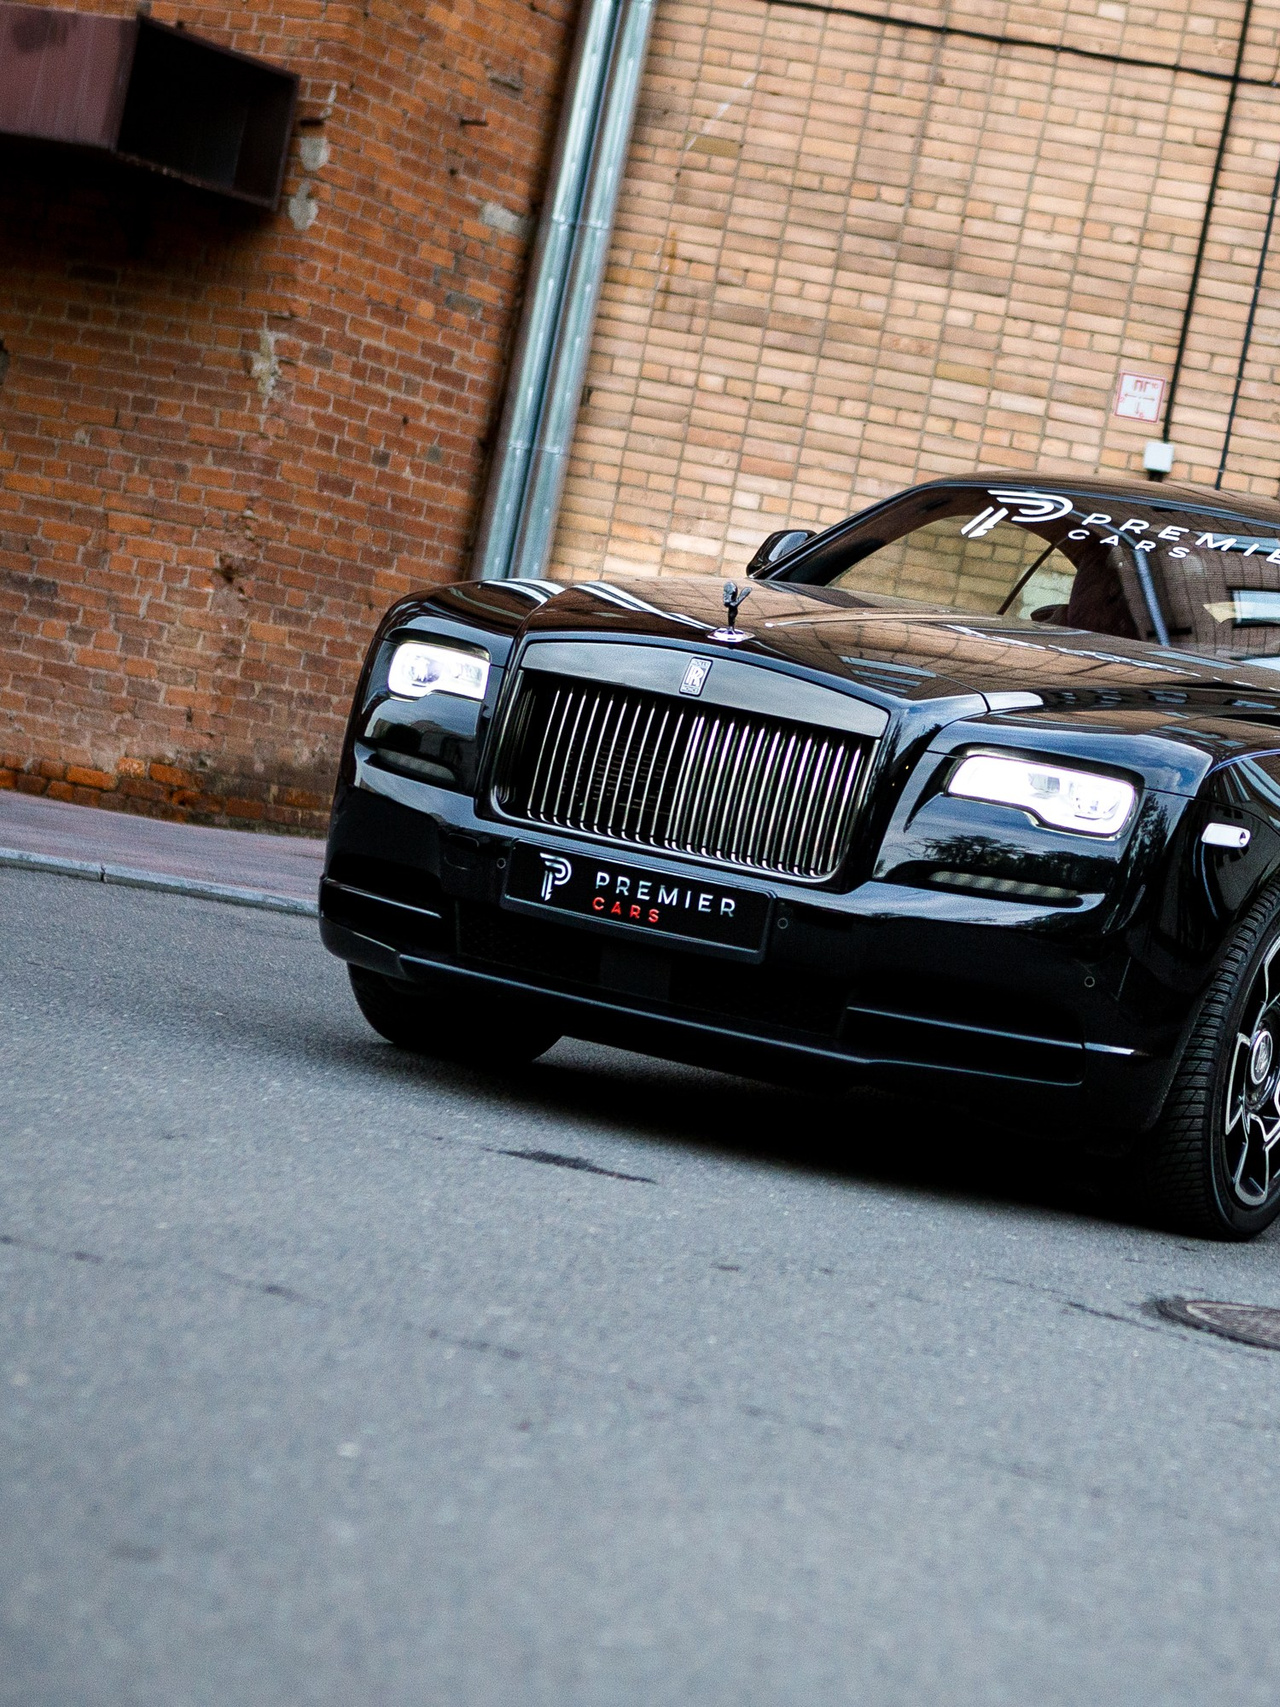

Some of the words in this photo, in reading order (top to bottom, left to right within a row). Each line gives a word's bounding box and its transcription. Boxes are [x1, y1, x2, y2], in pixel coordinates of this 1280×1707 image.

[1066, 528, 1191, 559] CARS
[592, 896, 661, 923] CARS
[595, 871, 736, 917] PREMIER
